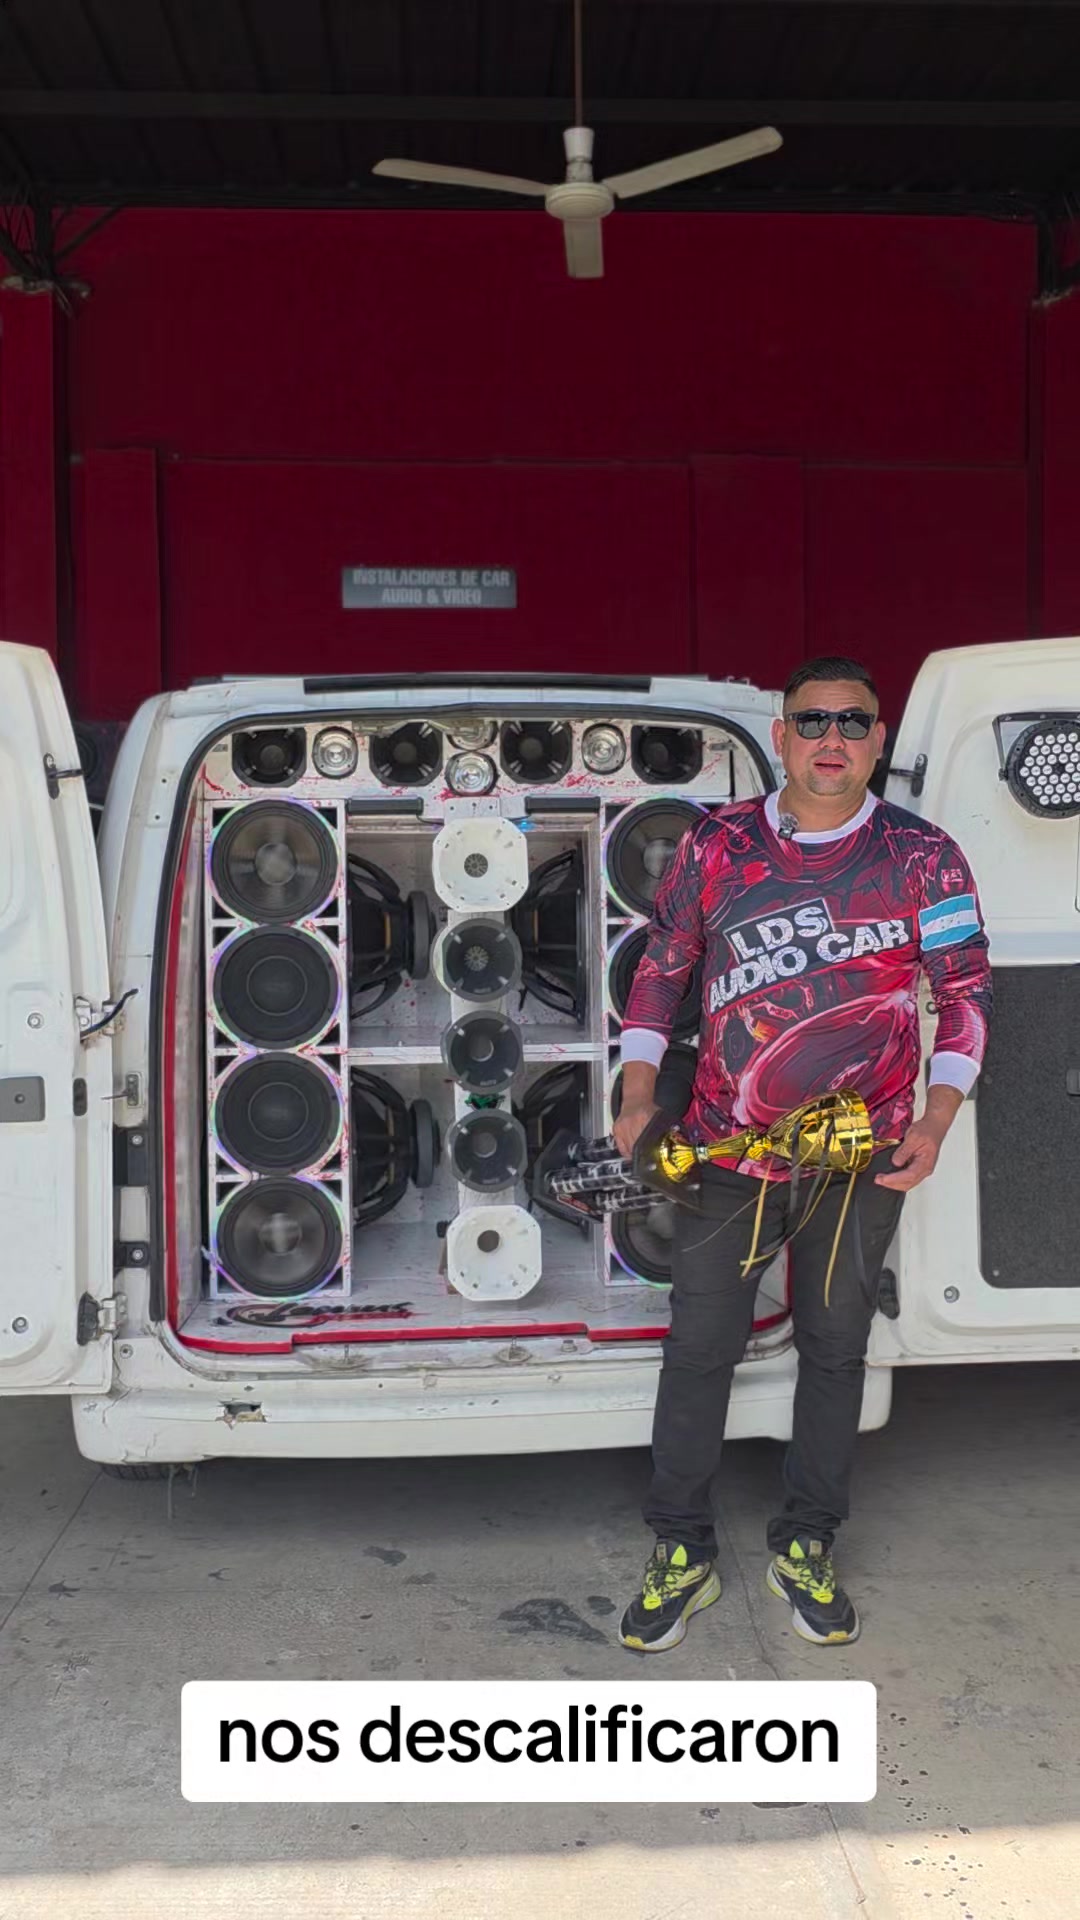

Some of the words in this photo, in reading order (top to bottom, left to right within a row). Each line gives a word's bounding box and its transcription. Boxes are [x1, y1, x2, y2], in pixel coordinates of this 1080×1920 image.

[352, 568, 457, 586] INSTALACIONES
[461, 569, 478, 586] DE
[481, 569, 510, 587] CAR
[381, 587, 422, 605] AUDIO
[426, 588, 439, 604] &
[443, 588, 482, 605] VIDEO
[709, 946, 808, 1014] AUDIO
[816, 919, 909, 963] CAR
